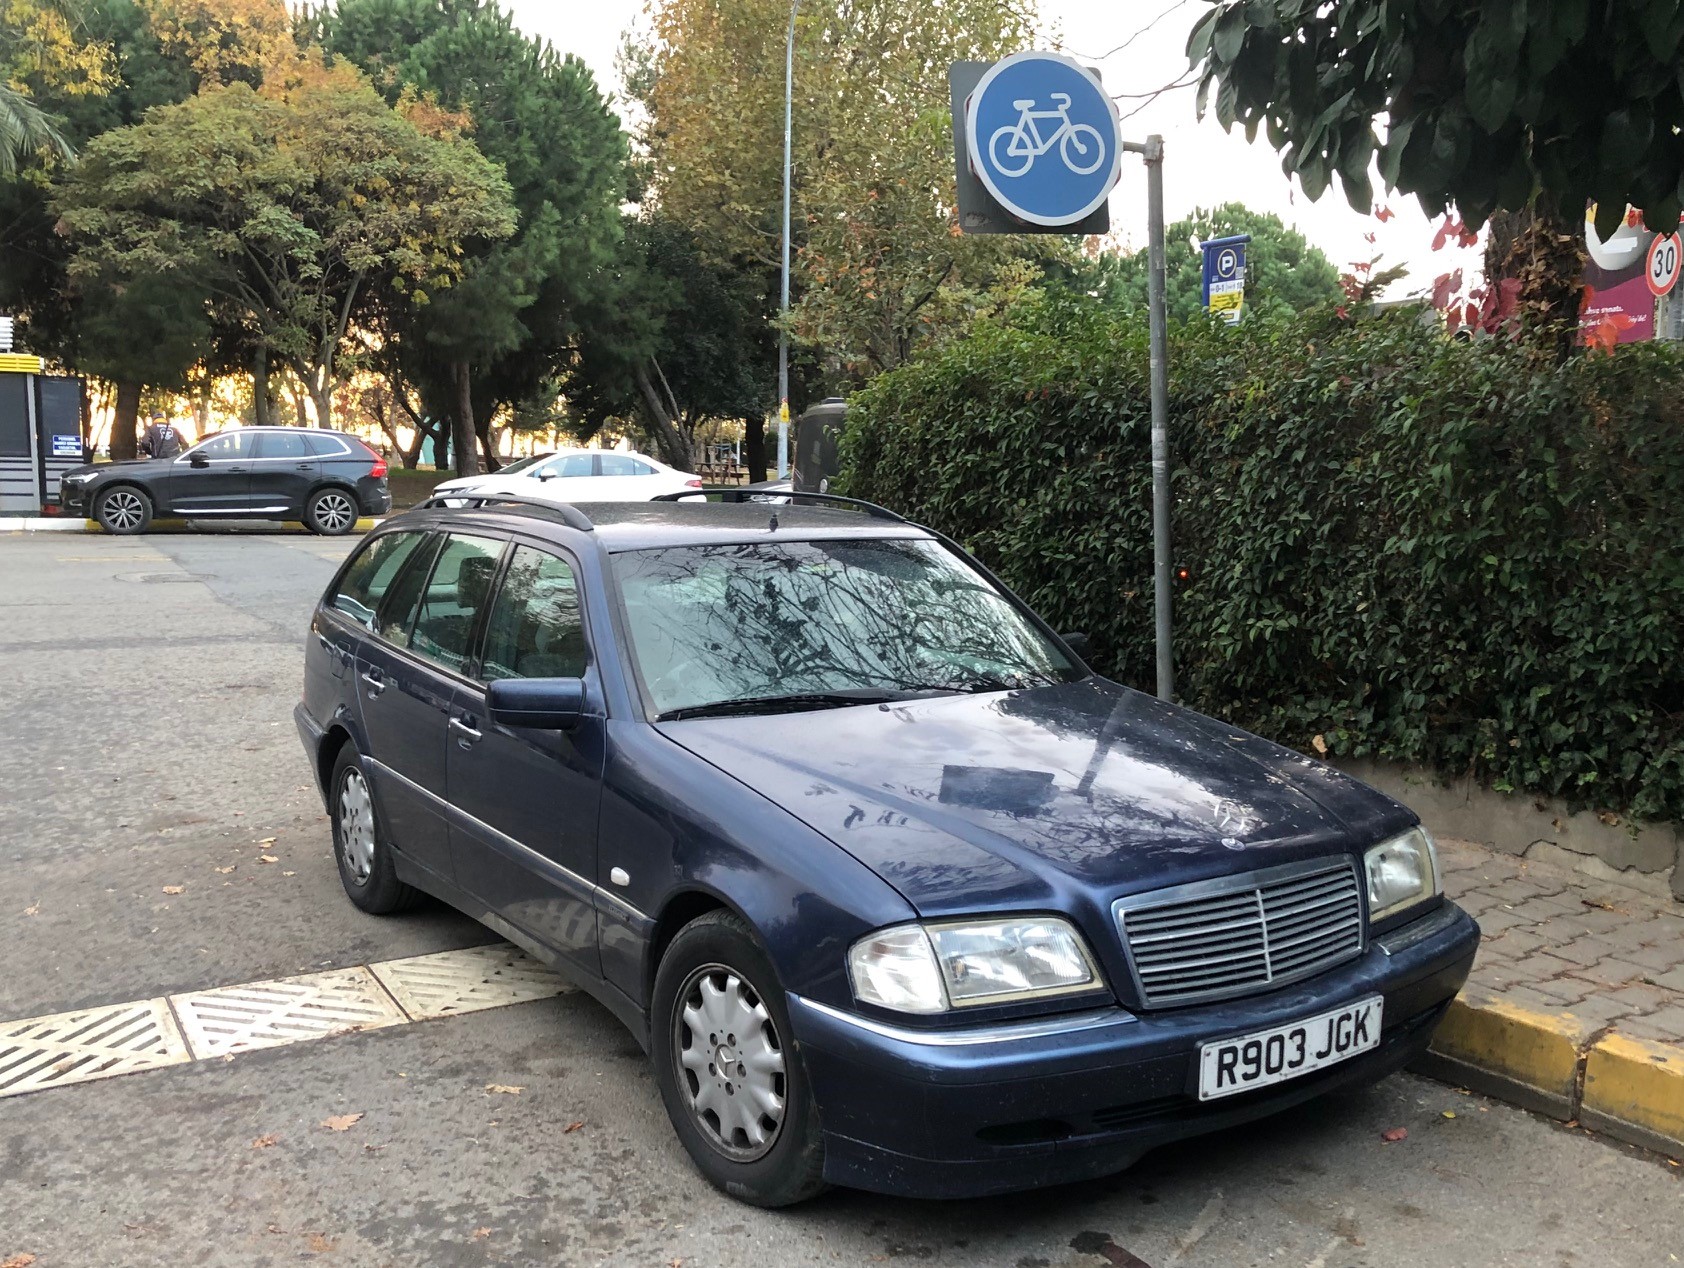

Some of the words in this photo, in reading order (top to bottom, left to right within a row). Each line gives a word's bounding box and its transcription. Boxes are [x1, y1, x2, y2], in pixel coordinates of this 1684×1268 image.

[1222, 256, 1233, 271] P
[1654, 246, 1675, 278] 30
[1217, 1027, 1306, 1088] R903
[1316, 1005, 1371, 1060] JGK
